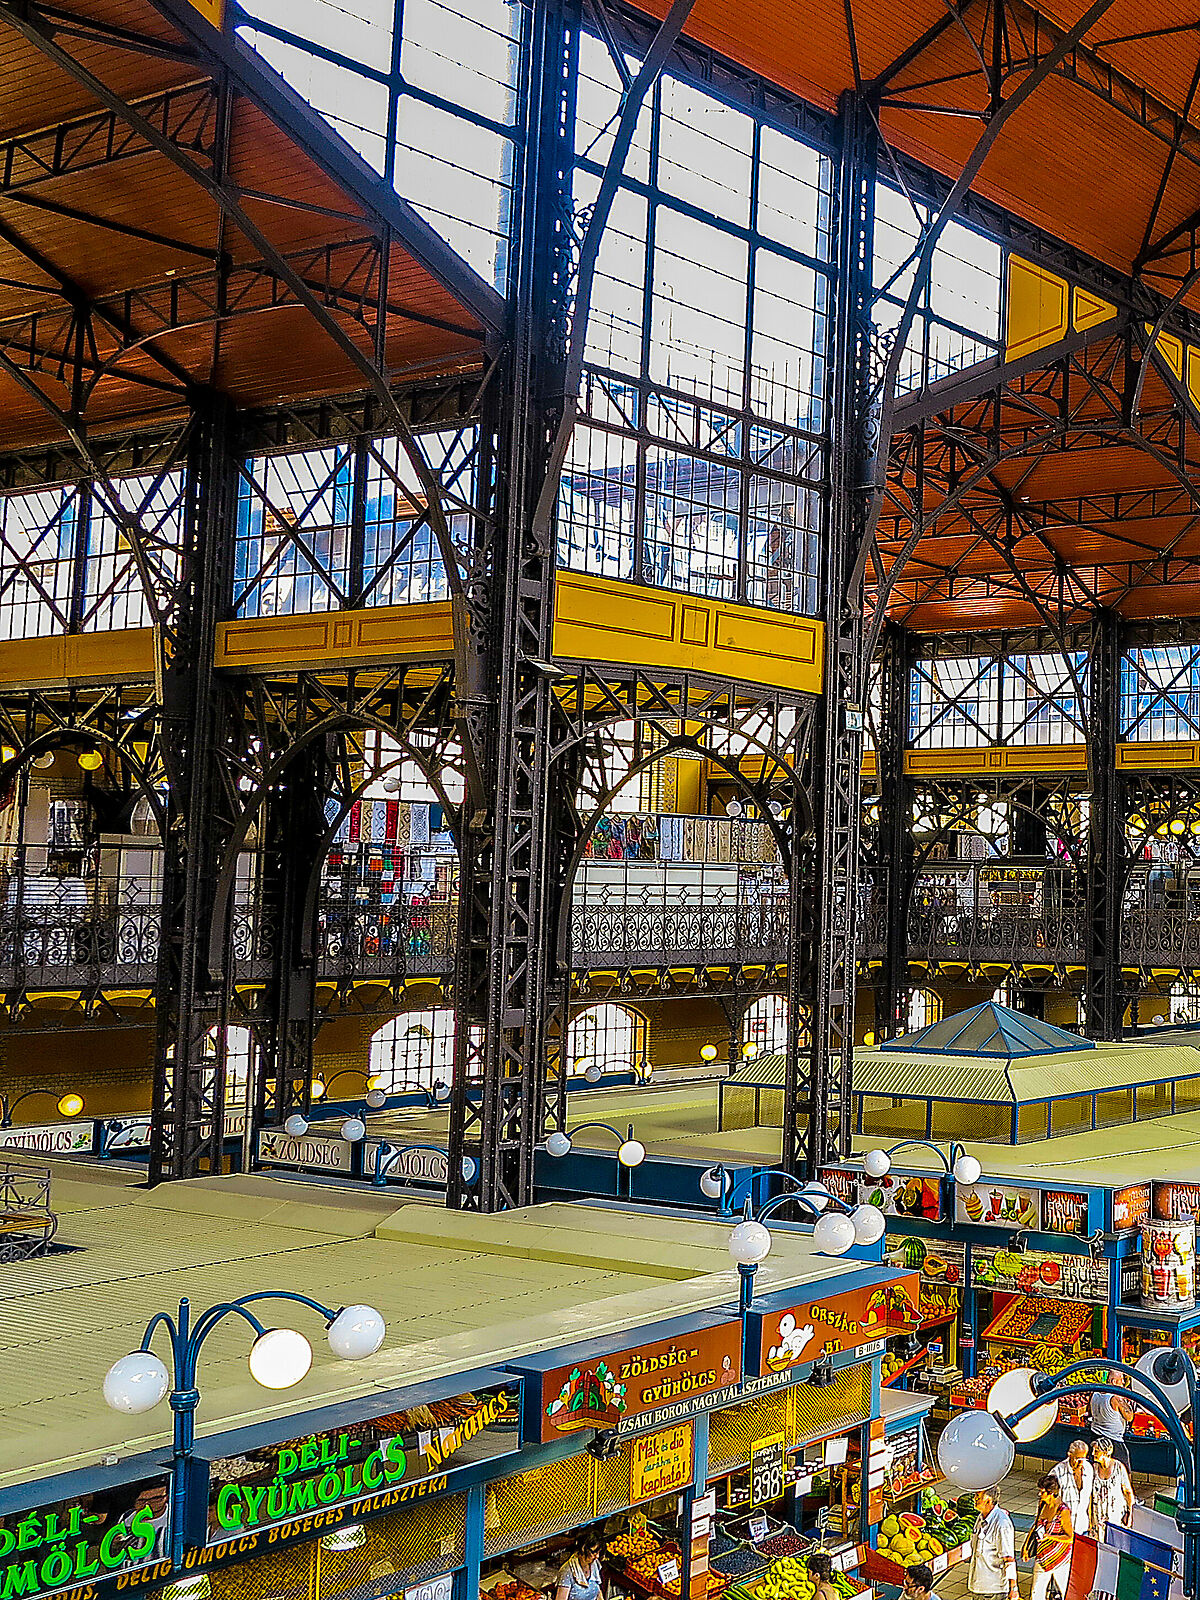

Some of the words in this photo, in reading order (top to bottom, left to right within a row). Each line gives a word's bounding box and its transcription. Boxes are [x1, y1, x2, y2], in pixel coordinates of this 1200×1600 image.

[278, 1136, 341, 1166] ZÖLDSÉG
[1047, 1191, 1083, 1204] NATURAL
[1045, 1217, 1082, 1234] JUICE
[1062, 1256, 1100, 1269] NATURAL
[1059, 1281, 1098, 1299] JUICE
[811, 1304, 858, 1334] ORSZÁG
[825, 1339, 844, 1355] BT.
[618, 1410, 652, 1434] IZSÁKI
[653, 1400, 689, 1425] BOROK
[691, 1392, 720, 1415] NAGY
[276, 1433, 362, 1477] DÉLI-
[424, 1390, 508, 1472] Narancs
[217, 1434, 407, 1532] GYÜMÖLCS
[640, 1461, 686, 1495] kapható!
[753, 1467, 780, 1504] 398
[0, 1505, 157, 1600] MÖLCS
